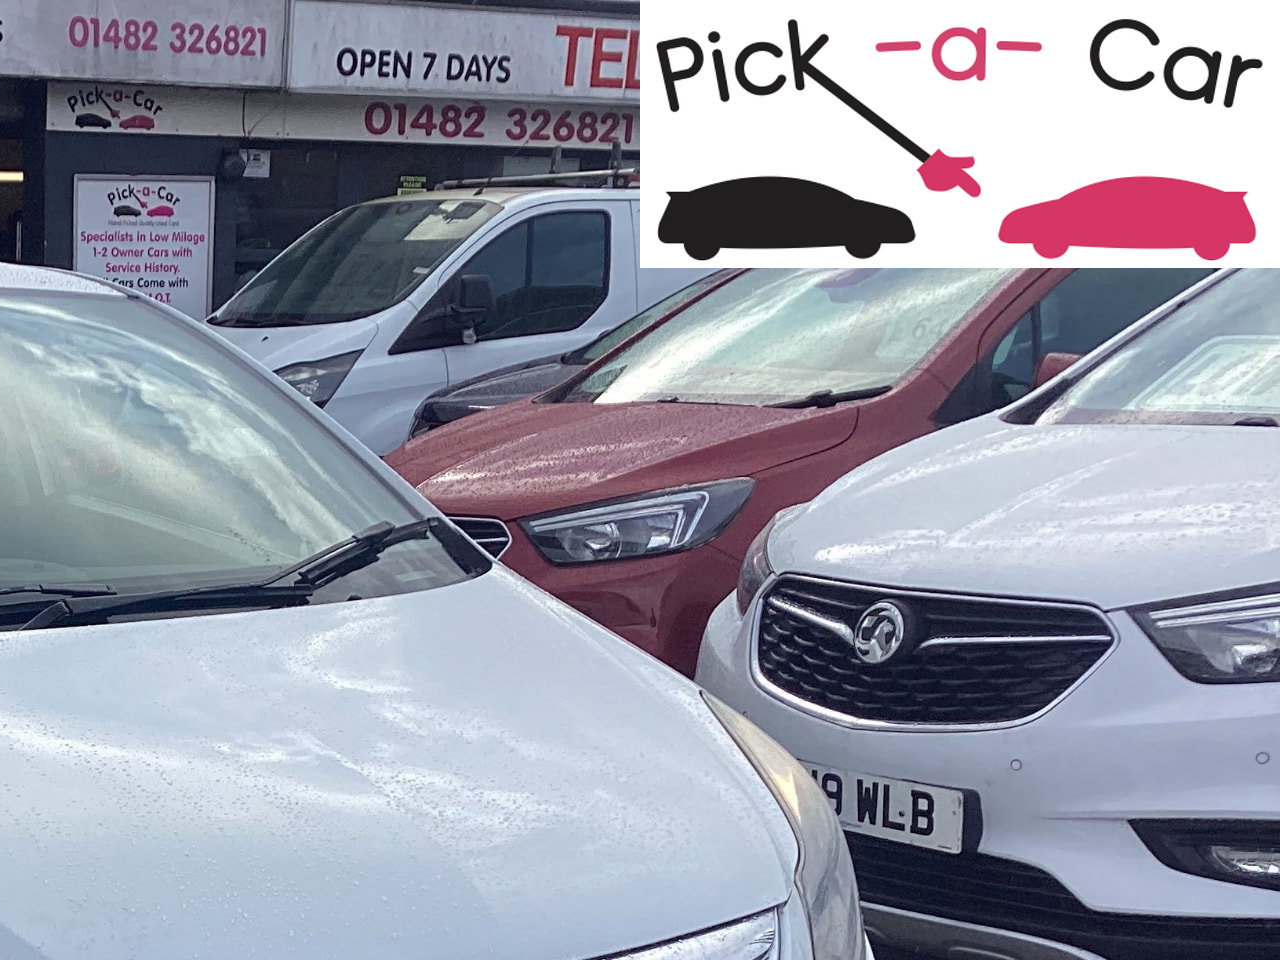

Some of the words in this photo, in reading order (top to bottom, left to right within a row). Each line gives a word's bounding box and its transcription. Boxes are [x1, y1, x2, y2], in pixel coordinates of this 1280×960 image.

[68, 15, 158, 51] 01482
[169, 22, 267, 57] 326821
[336, 47, 412, 80] OPEN
[422, 52, 438, 80] 7
[445, 53, 512, 83] DAYS
[364, 101, 486, 138] 01482
[505, 107, 634, 144] 326821
[80, 231, 133, 244] Specialists
[136, 231, 146, 242] in
[149, 231, 169, 242] Low
[171, 231, 205, 245] Milage
[92, 247, 108, 257] 1-2
[111, 247, 144, 257] Owner
[147, 247, 169, 257] Cars
[172, 247, 192, 257] with
[105, 262, 141, 273] Service
[137, 278, 165, 288] Come
[168, 277, 188, 288] with
[856, 779, 935, 836] WLB
